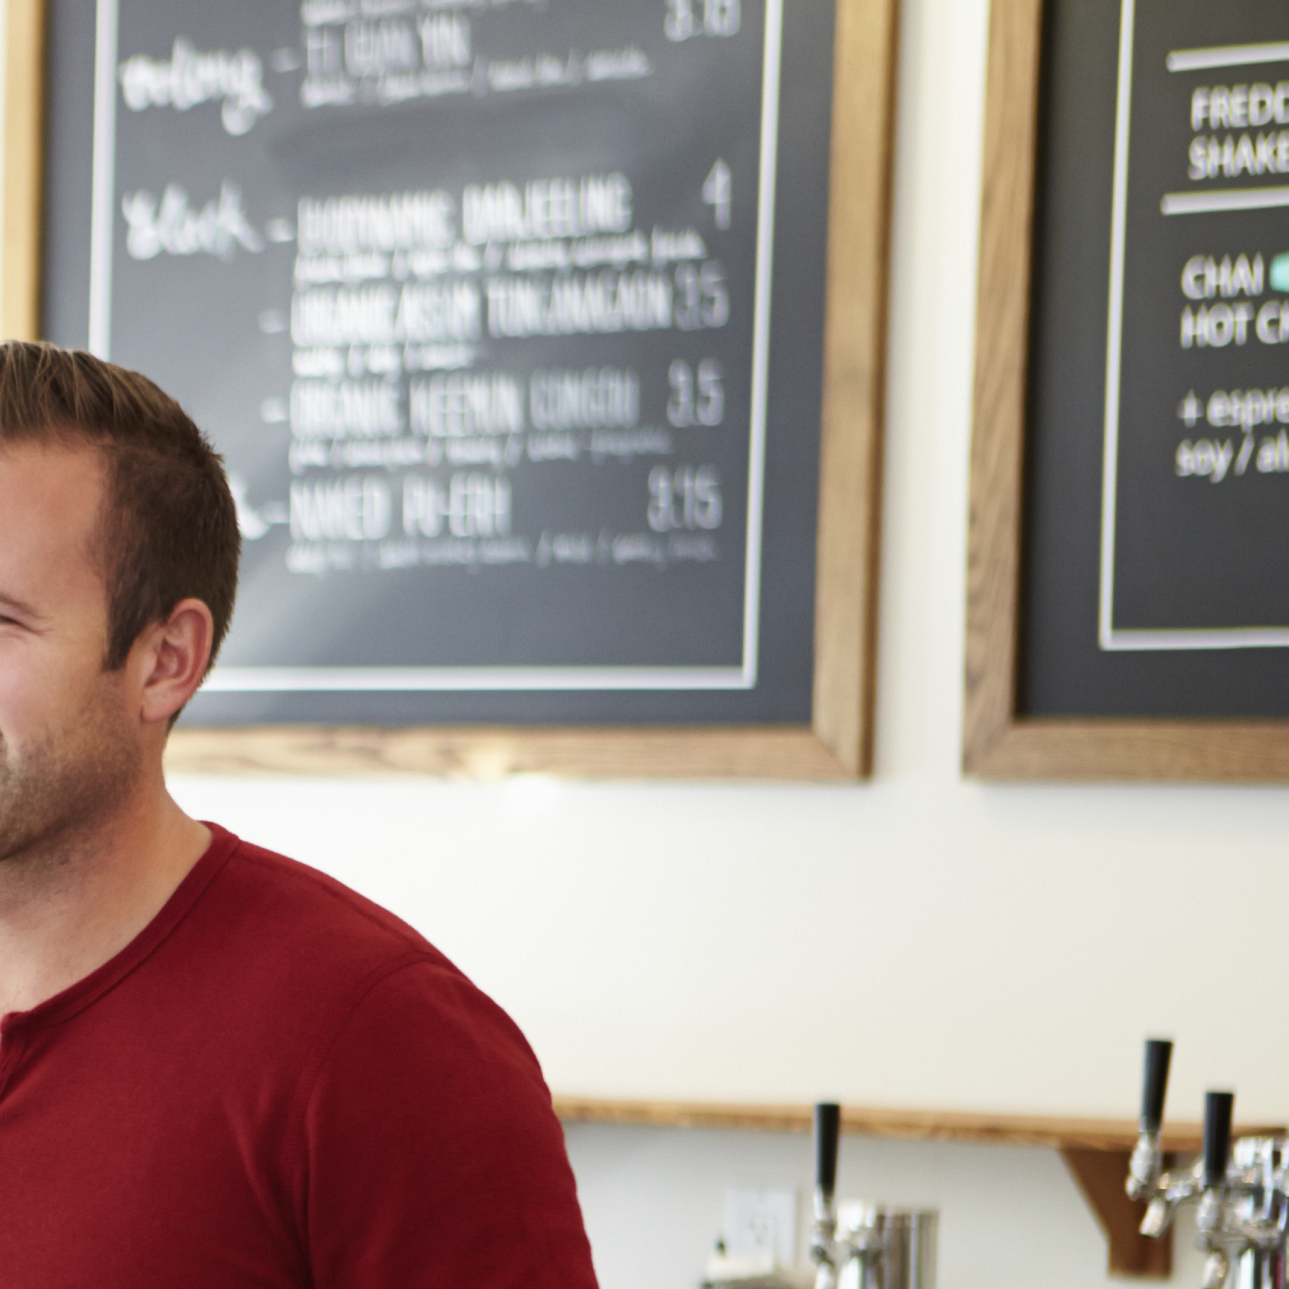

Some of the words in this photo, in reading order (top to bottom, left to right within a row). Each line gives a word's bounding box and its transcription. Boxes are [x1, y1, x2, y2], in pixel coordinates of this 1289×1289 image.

[702, 157, 731, 230] 4
[1180, 252, 1265, 300] CHAI
[1179, 302, 1254, 349] HOT
[1175, 437, 1233, 484] soy
